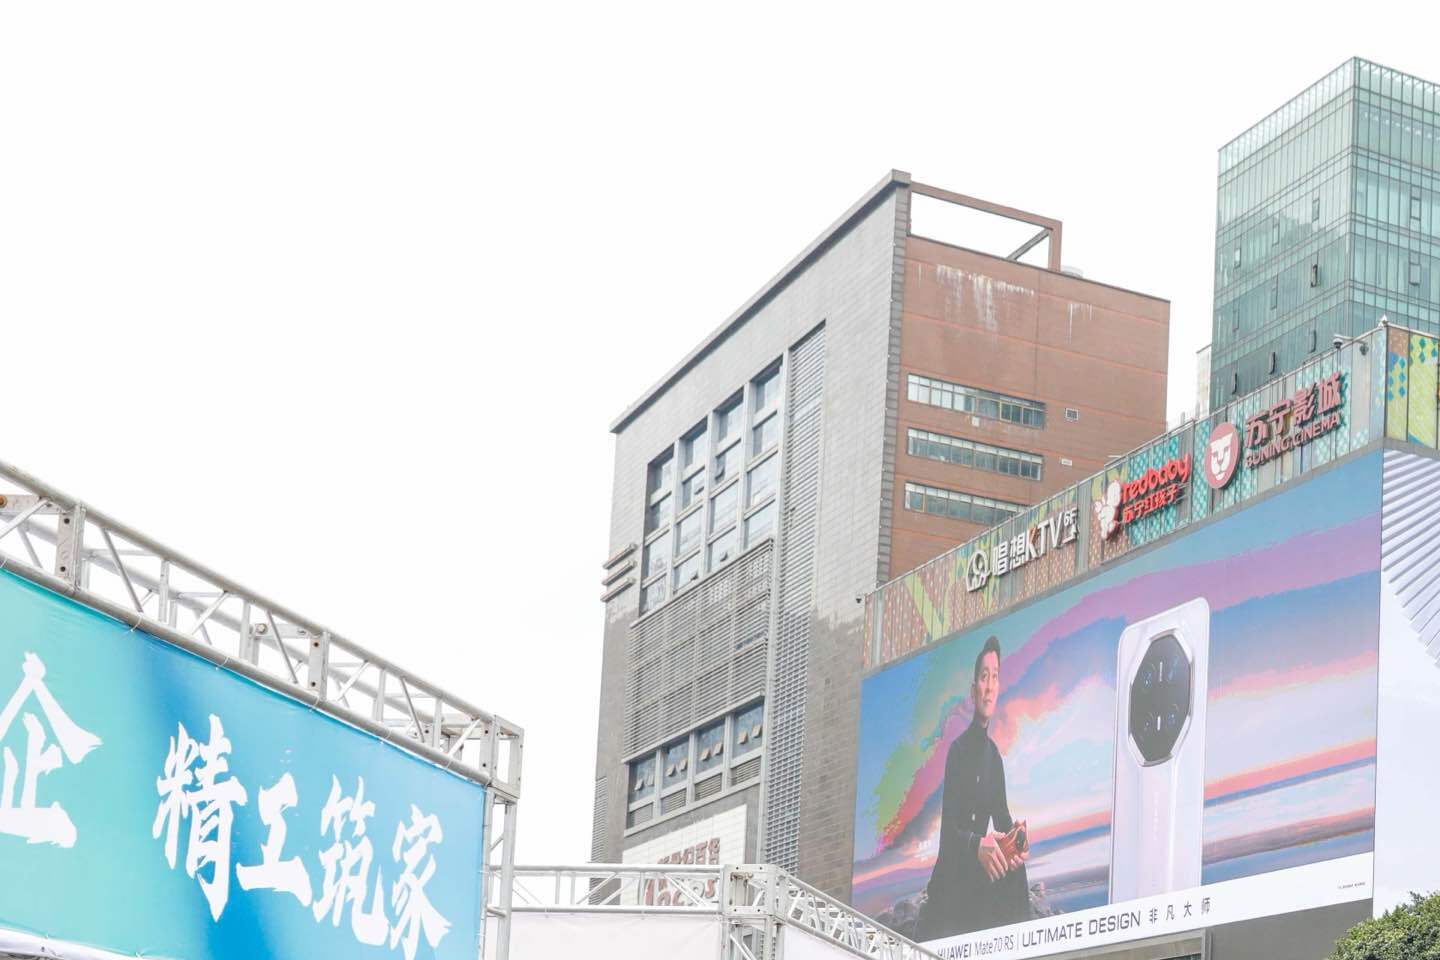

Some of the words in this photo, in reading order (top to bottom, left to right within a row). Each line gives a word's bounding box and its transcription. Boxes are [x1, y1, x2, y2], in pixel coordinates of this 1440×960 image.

[1245, 371, 1343, 449] 苏宁影城
[1121, 454, 1191, 497] redbaby
[1022, 922, 1083, 948] ULTIMATE
[1088, 910, 1141, 935] DESIGN
[1149, 896, 1211, 923] 非凡大师
